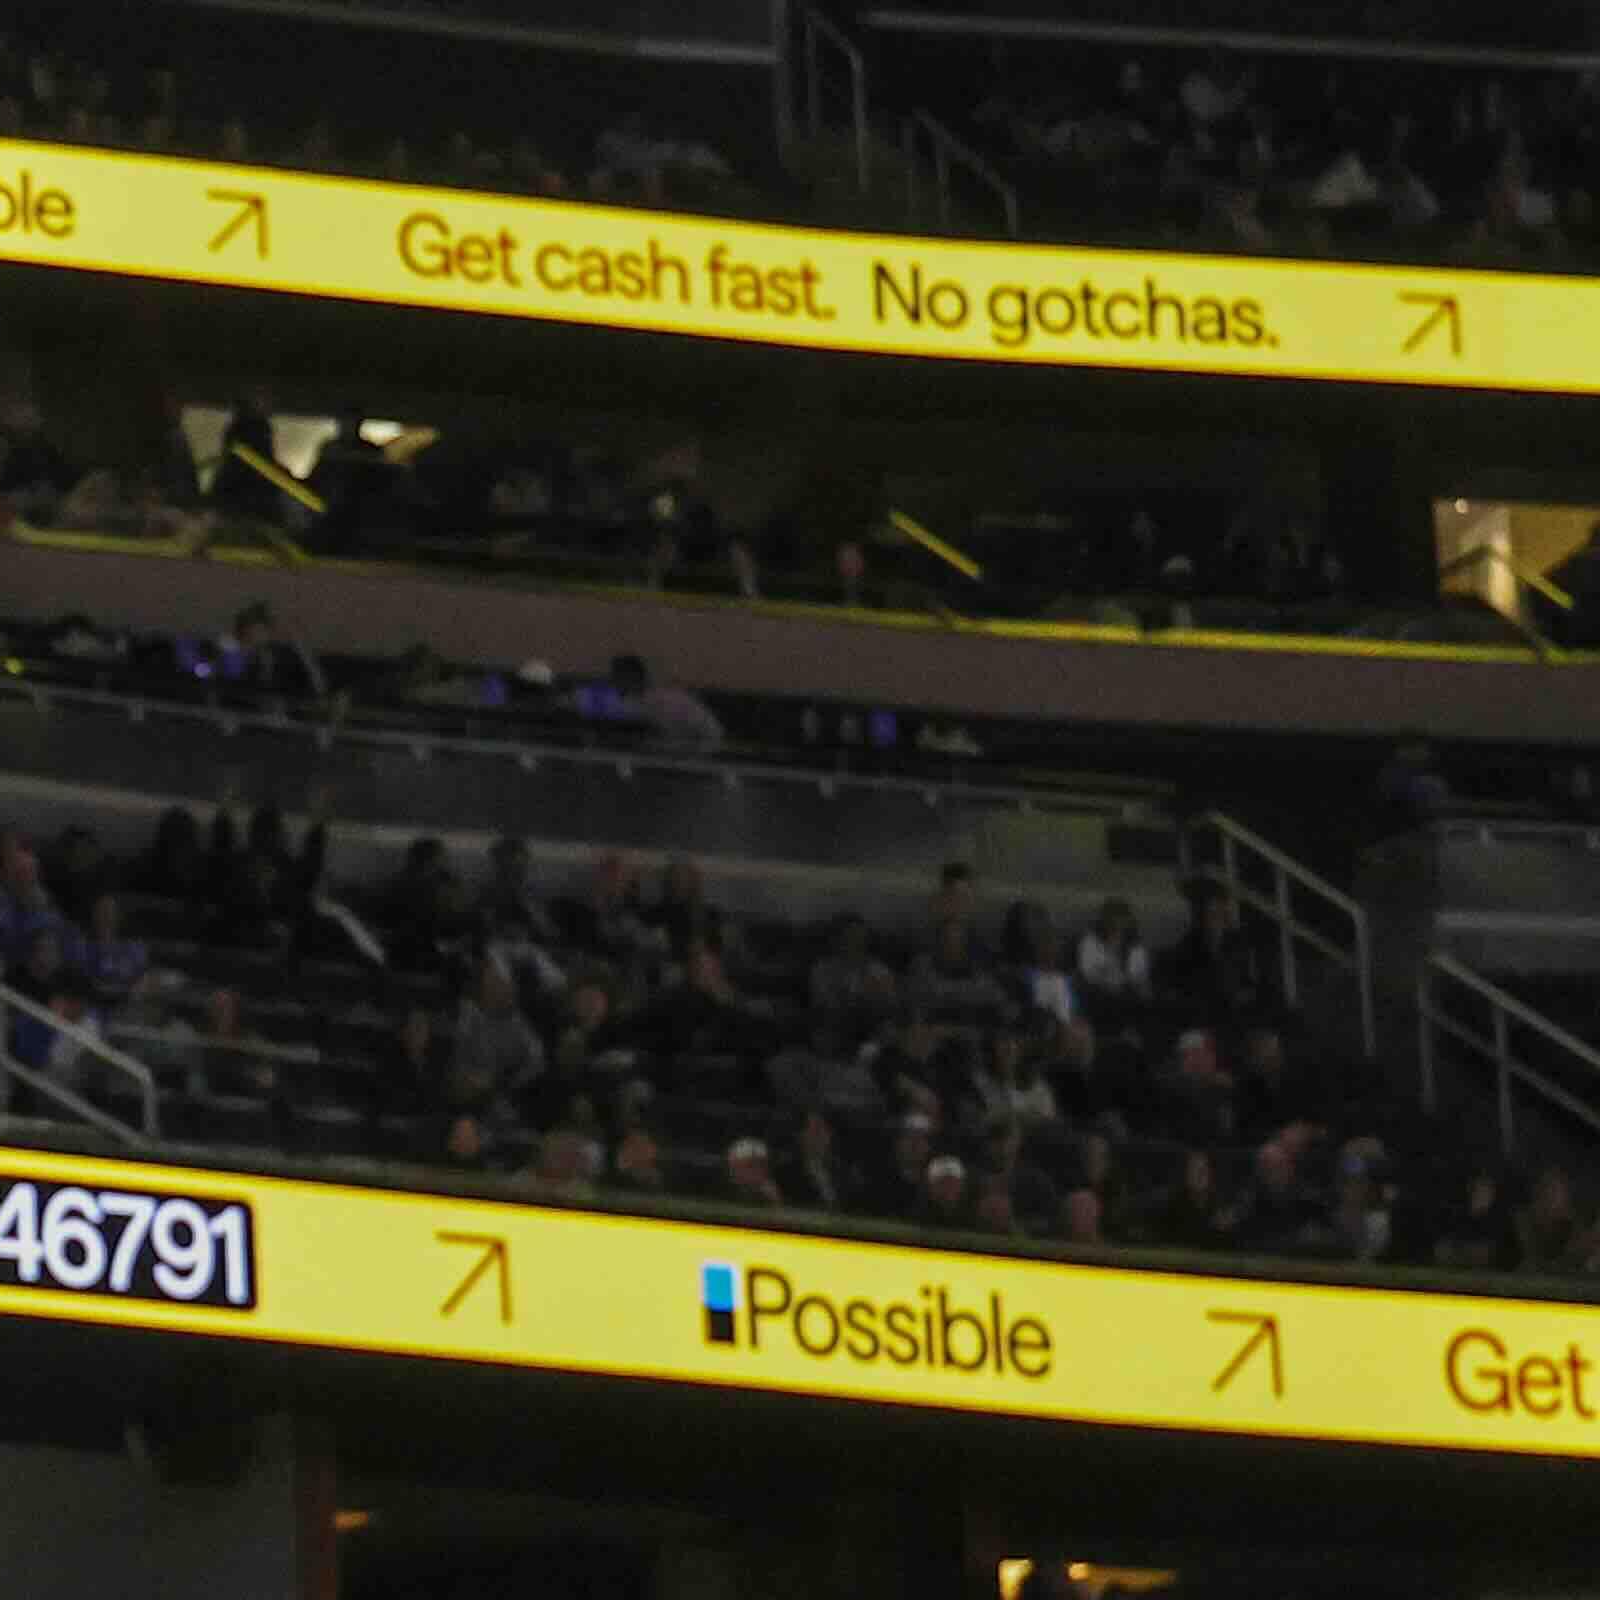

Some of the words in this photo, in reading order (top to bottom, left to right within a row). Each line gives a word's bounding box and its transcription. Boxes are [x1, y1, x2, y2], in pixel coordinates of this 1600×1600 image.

[399, 212, 521, 287] Get
[535, 238, 692, 305] cash
[704, 241, 837, 320] fast.
[873, 260, 969, 329] No
[988, 278, 1279, 348] gotchas.
[746, 1266, 1053, 1378] Possible
[1445, 1327, 1599, 1421] Get
